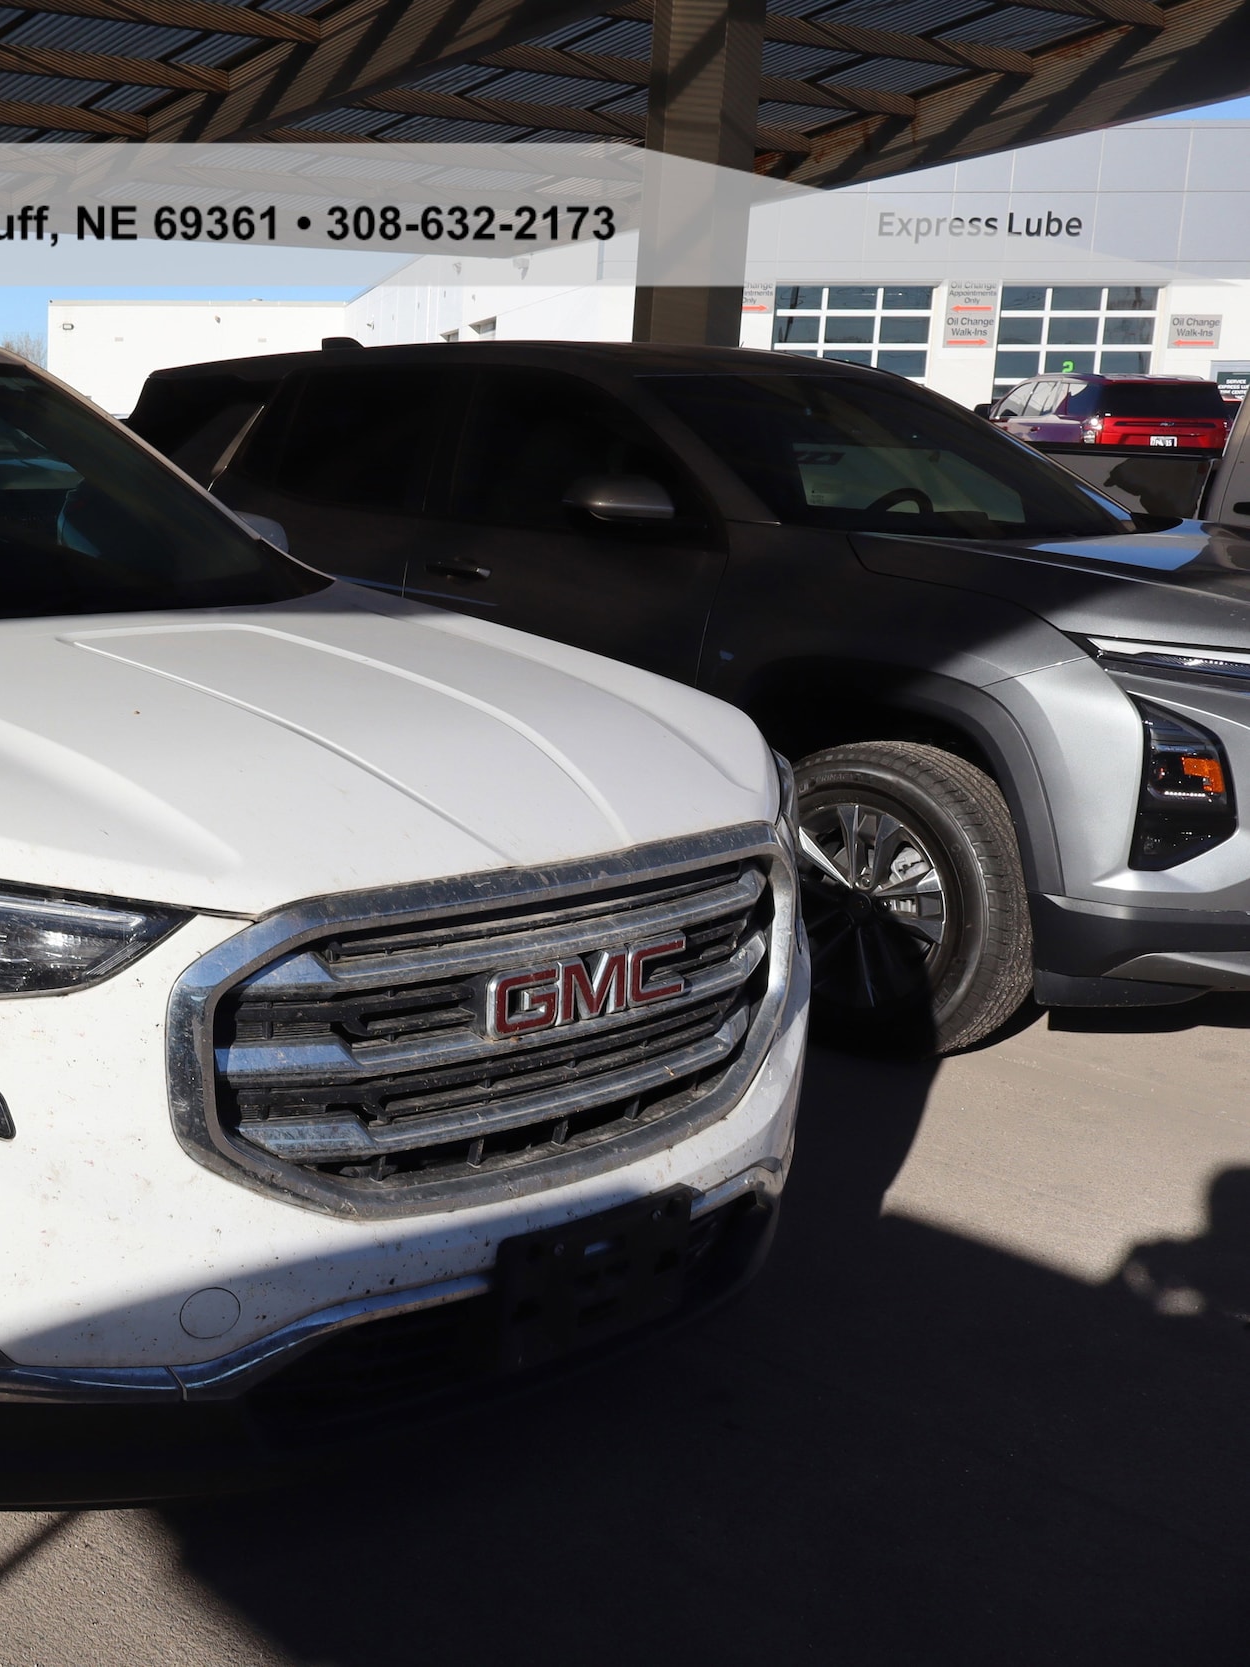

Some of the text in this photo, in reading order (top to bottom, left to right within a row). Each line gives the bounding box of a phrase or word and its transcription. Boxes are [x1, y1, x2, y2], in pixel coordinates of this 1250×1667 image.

[877, 210, 1083, 244] Express Lube
[964, 281, 997, 291] Change
[946, 317, 995, 327] Oil Change
[1172, 317, 1221, 328] Oil Change
[951, 328, 988, 336] Walk-Ins
[1176, 328, 1214, 337] Walk-Ins
[486, 929, 686, 1040] GMC
